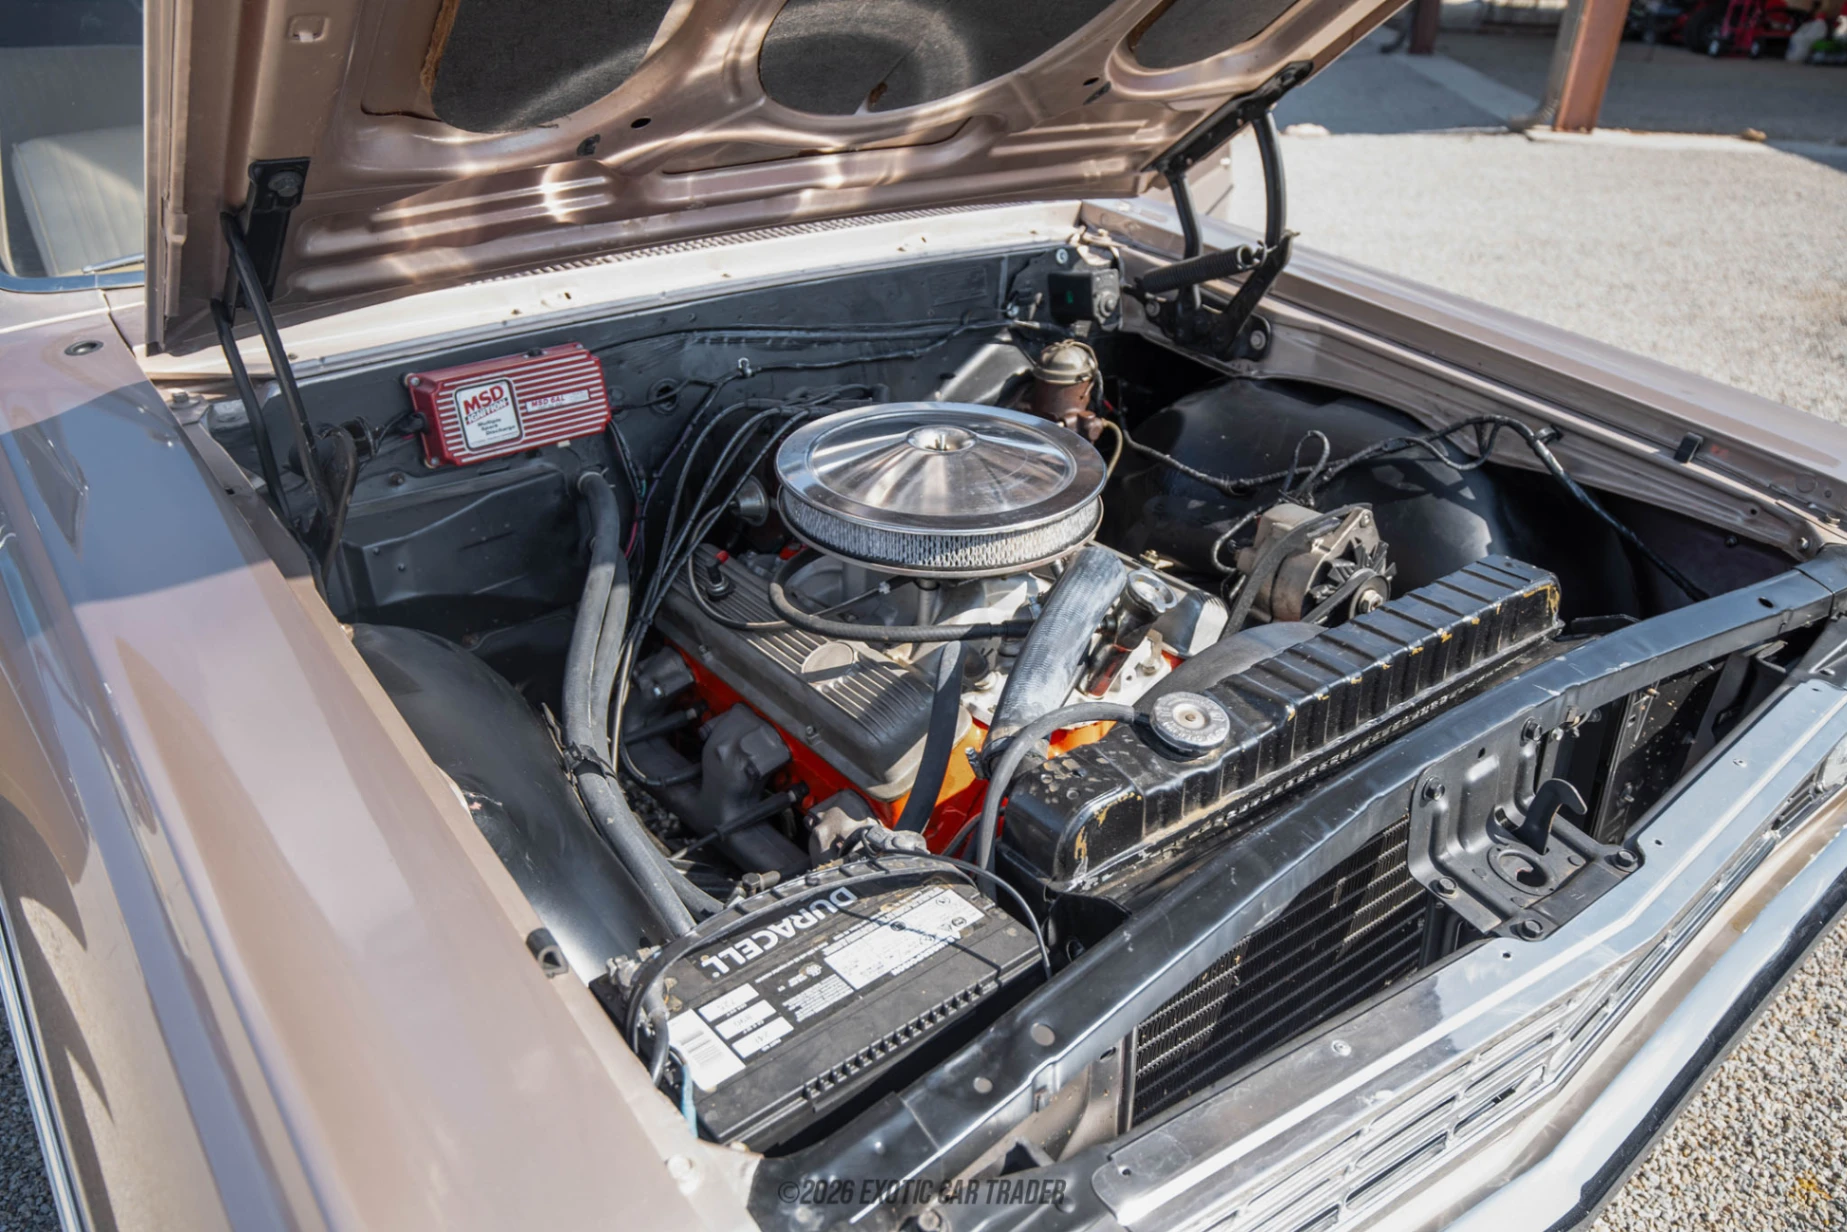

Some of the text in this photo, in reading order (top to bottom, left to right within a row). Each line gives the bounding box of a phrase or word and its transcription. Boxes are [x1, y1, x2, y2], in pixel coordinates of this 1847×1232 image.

[463, 385, 505, 415] MSD
[466, 397, 508, 424] IGNITION
[531, 399, 549, 408] MSD
[700, 886, 858, 976] DURACELL
